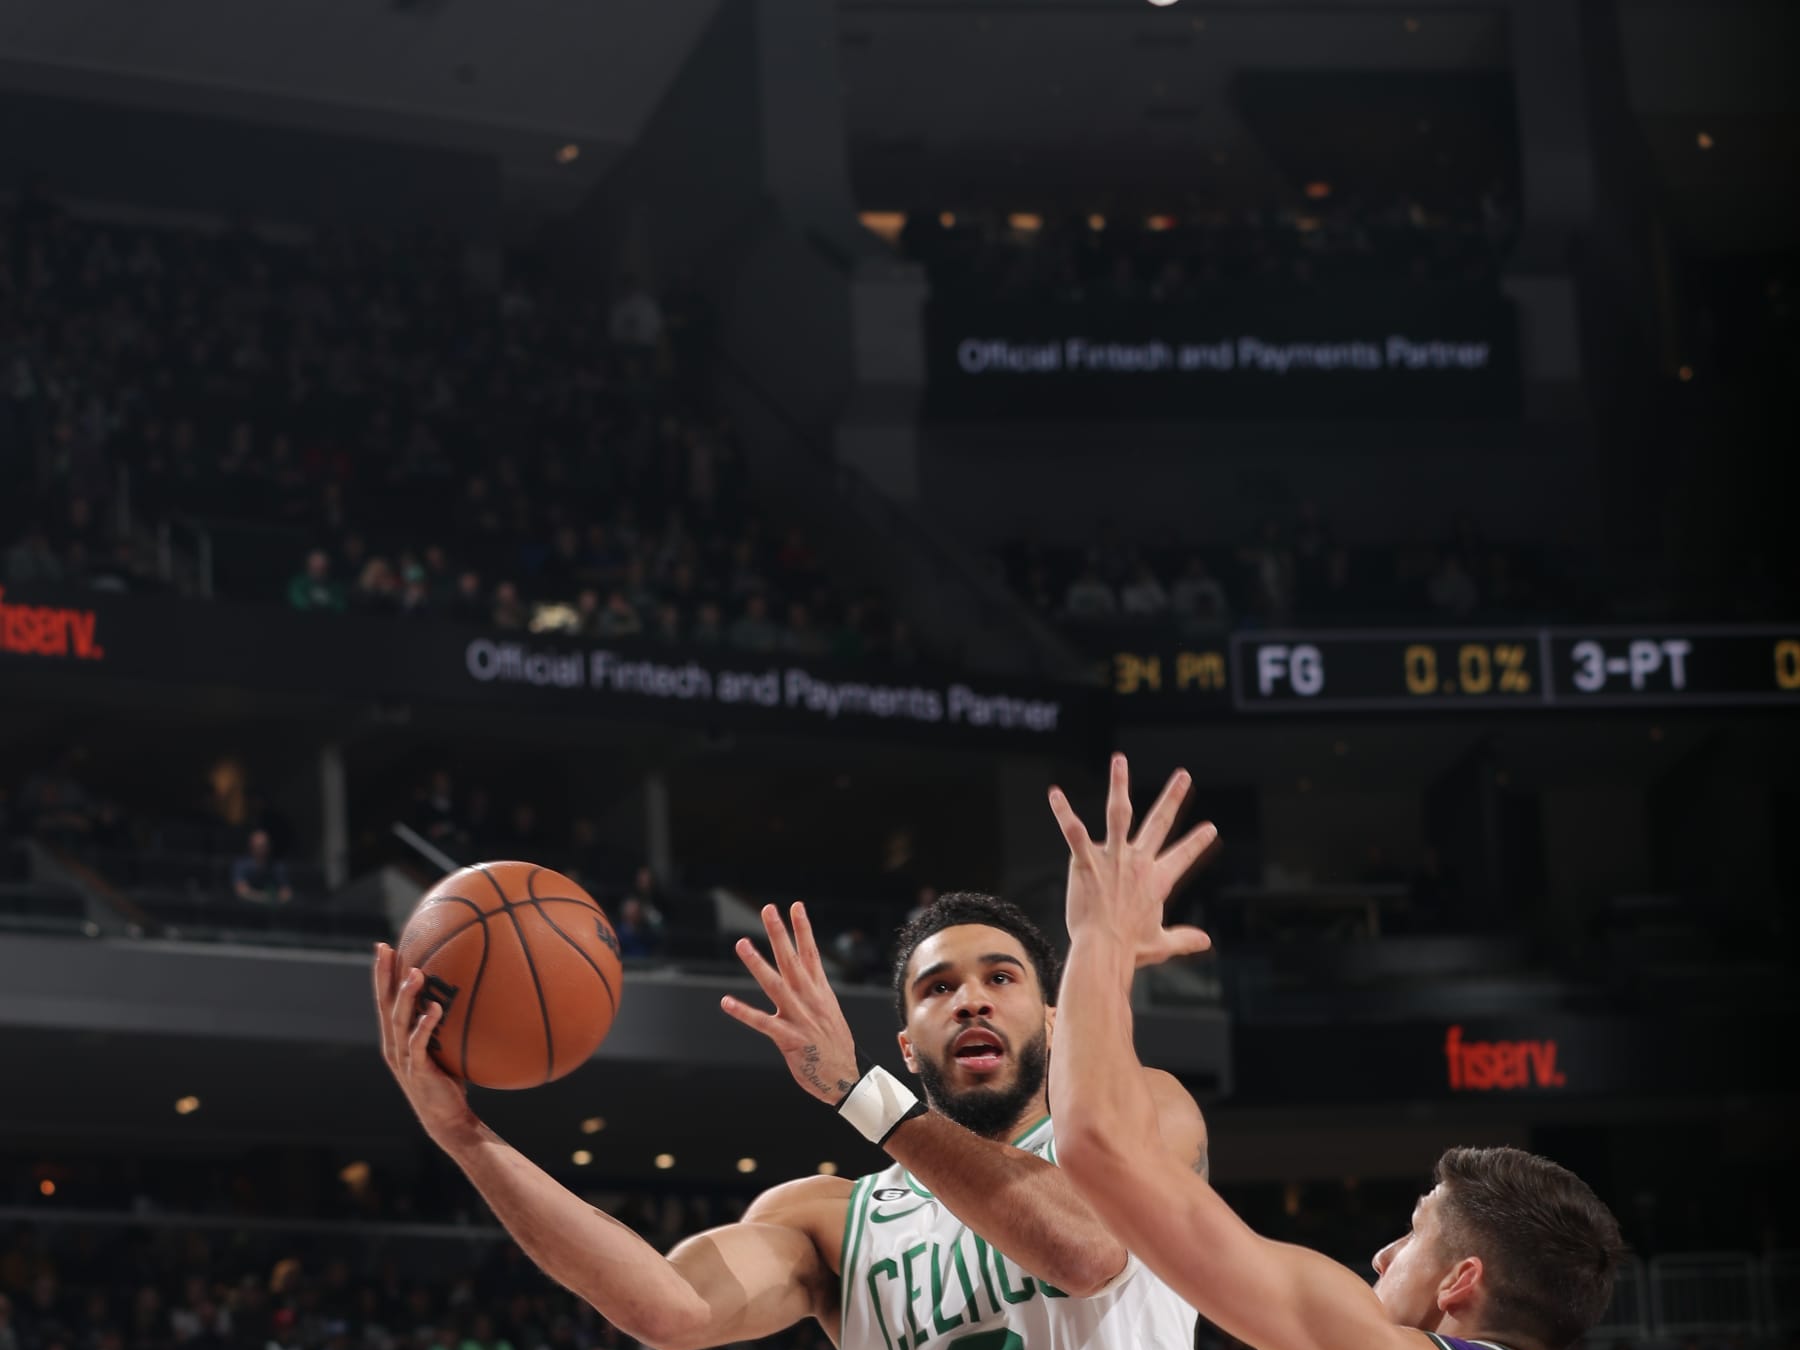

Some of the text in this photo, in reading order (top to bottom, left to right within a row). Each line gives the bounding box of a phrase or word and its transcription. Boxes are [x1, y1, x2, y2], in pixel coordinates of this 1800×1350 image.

[959, 335, 1489, 375] Official Fintech and Payments Partner
[465, 637, 1059, 731] Official Fintech and Payments Partner
[1257, 644, 1531, 695] FG 0.0%
[1572, 640, 1691, 692] 3-PT
